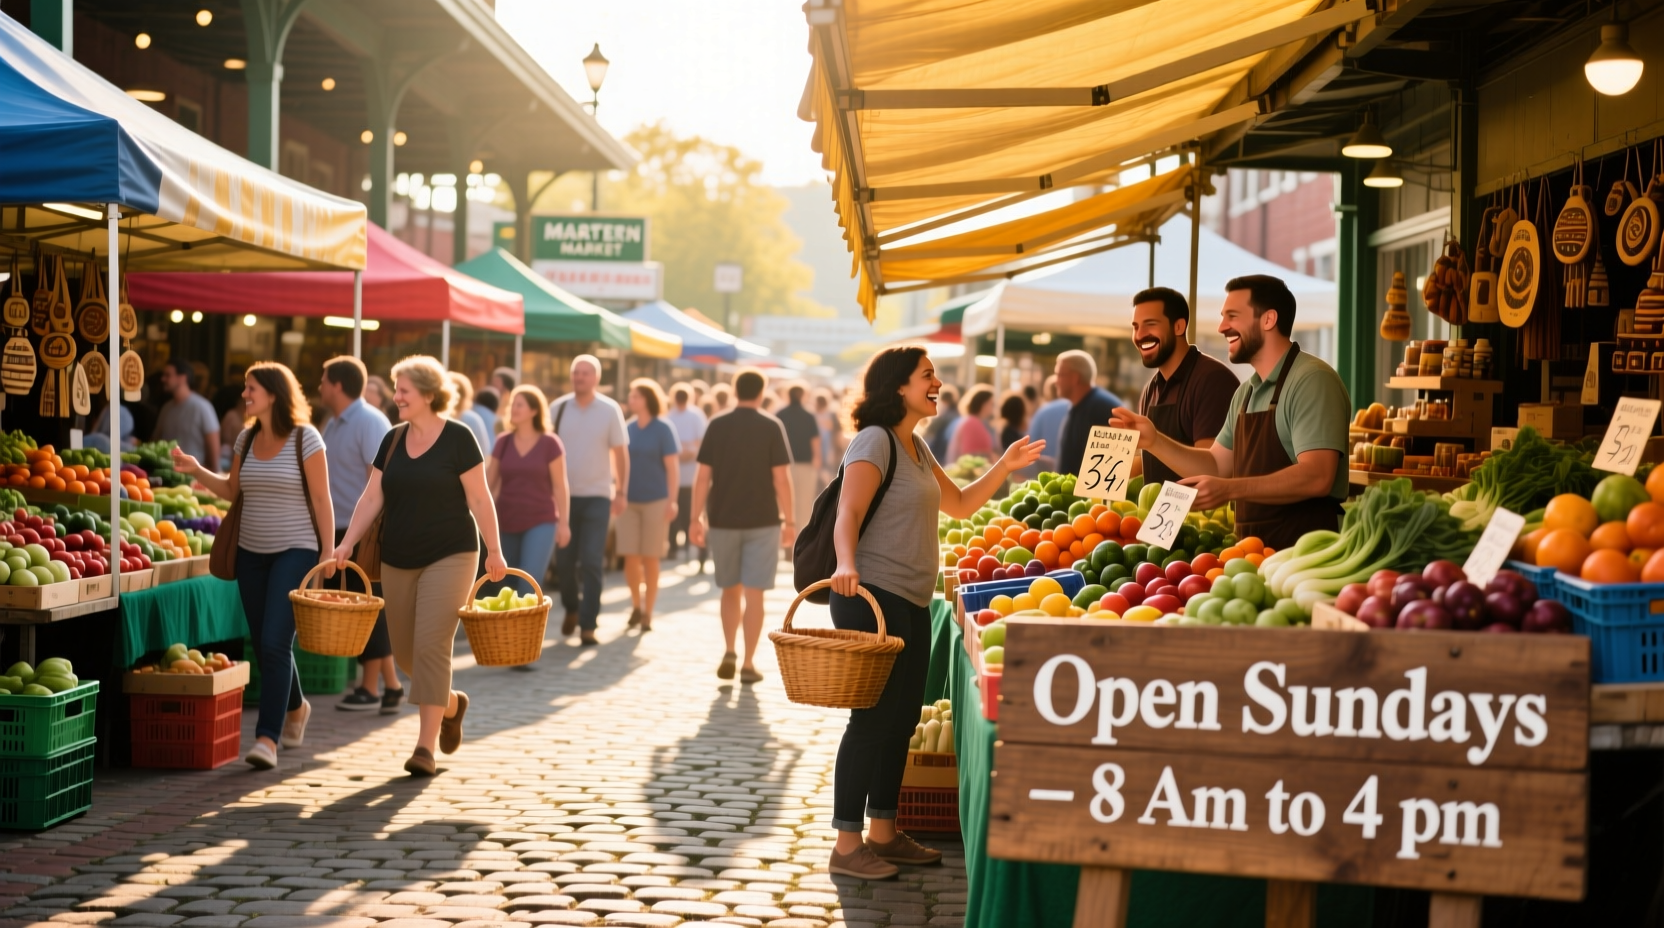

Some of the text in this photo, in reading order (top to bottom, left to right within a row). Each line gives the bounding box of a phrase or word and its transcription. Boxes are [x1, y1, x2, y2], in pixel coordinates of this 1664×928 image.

[560, 241, 622, 256] MARKET
[1034, 654, 1548, 764] Open Sundays
[1090, 763, 1125, 823] 8
[1138, 766, 1248, 830] Am
[1265, 780, 1325, 836] to
[1343, 775, 1383, 838] 4
[1396, 797, 1502, 859] pm
